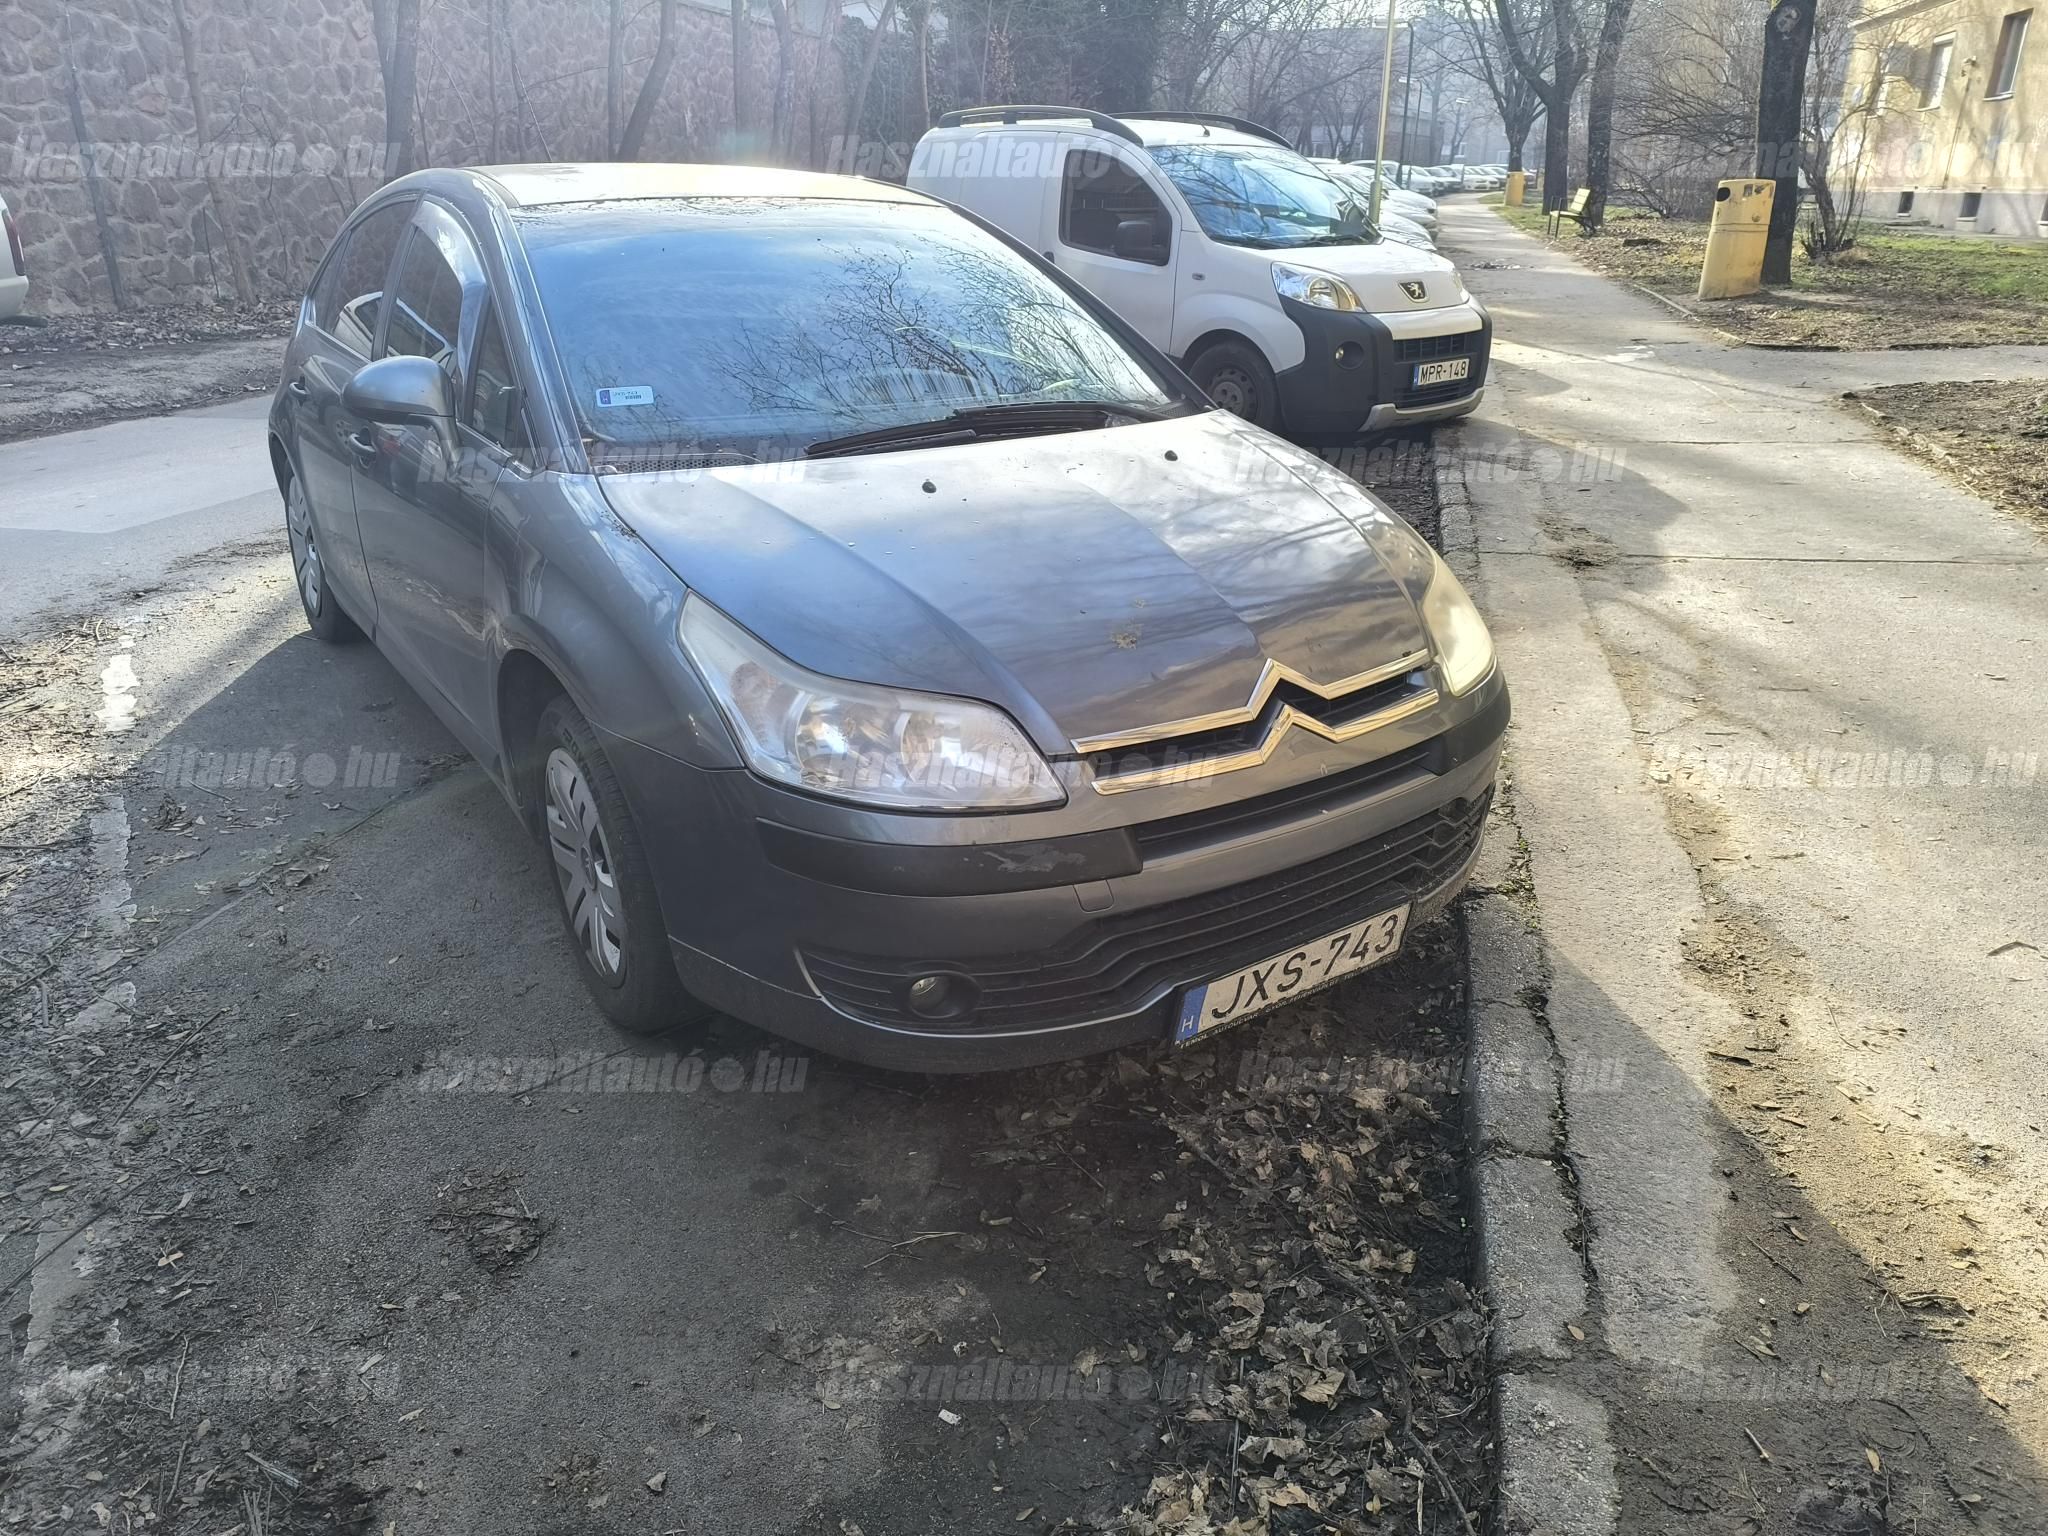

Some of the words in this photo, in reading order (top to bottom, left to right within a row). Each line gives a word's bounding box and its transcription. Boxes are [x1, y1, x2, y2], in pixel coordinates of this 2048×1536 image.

[1420, 361, 1467, 383] MPR-148
[1211, 914, 1398, 1019] JXS-743
[1181, 1015, 1194, 1033] H
